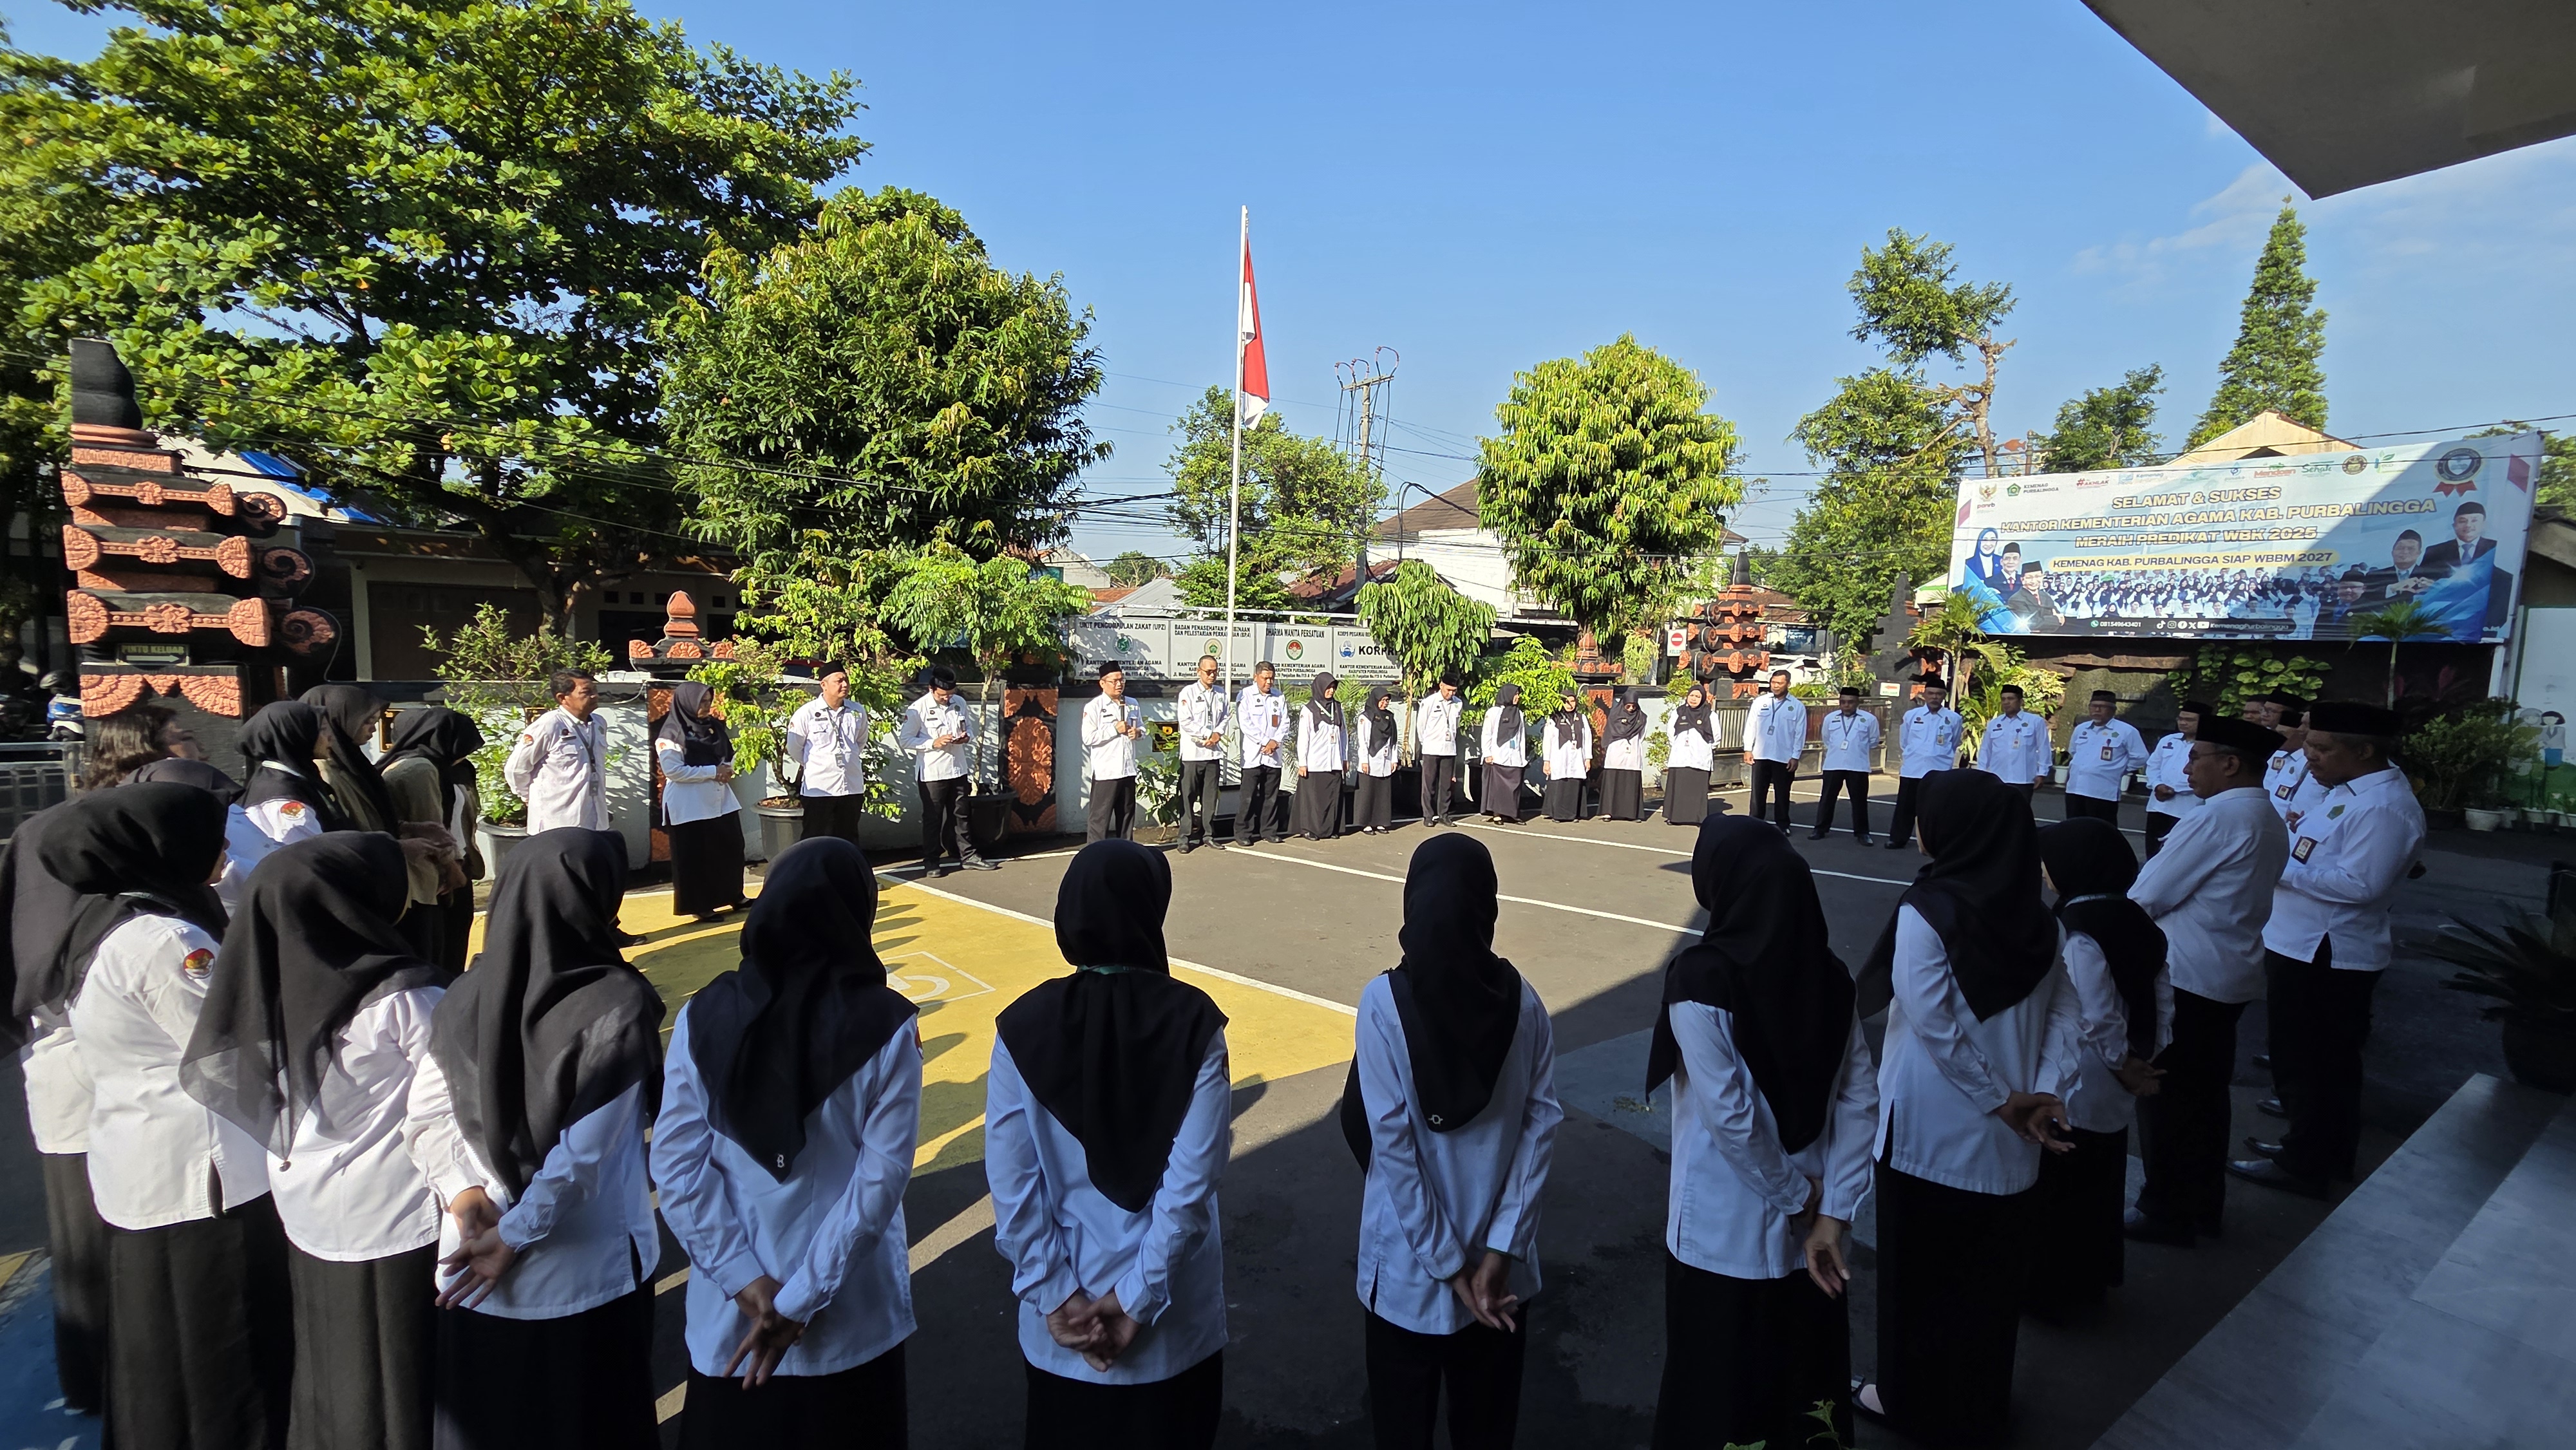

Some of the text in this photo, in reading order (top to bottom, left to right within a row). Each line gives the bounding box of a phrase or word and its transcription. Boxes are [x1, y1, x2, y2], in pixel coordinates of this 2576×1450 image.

[2112, 486, 2282, 509] SELAMAT & SUKSES
[2001, 498, 2438, 533] KANTOR KEMENTERIAN AGAMA KAB. PURBALINGGA
[2075, 525, 2318, 548] MERAIH PREDIKAT WBK 2025
[2053, 552, 2333, 568] KEMENAG KAB. PURBALINGGA SIAP WBBM 2027
[1284, 628, 1300, 637] WANITA
[1301, 630, 1325, 638] PERSATUAN
